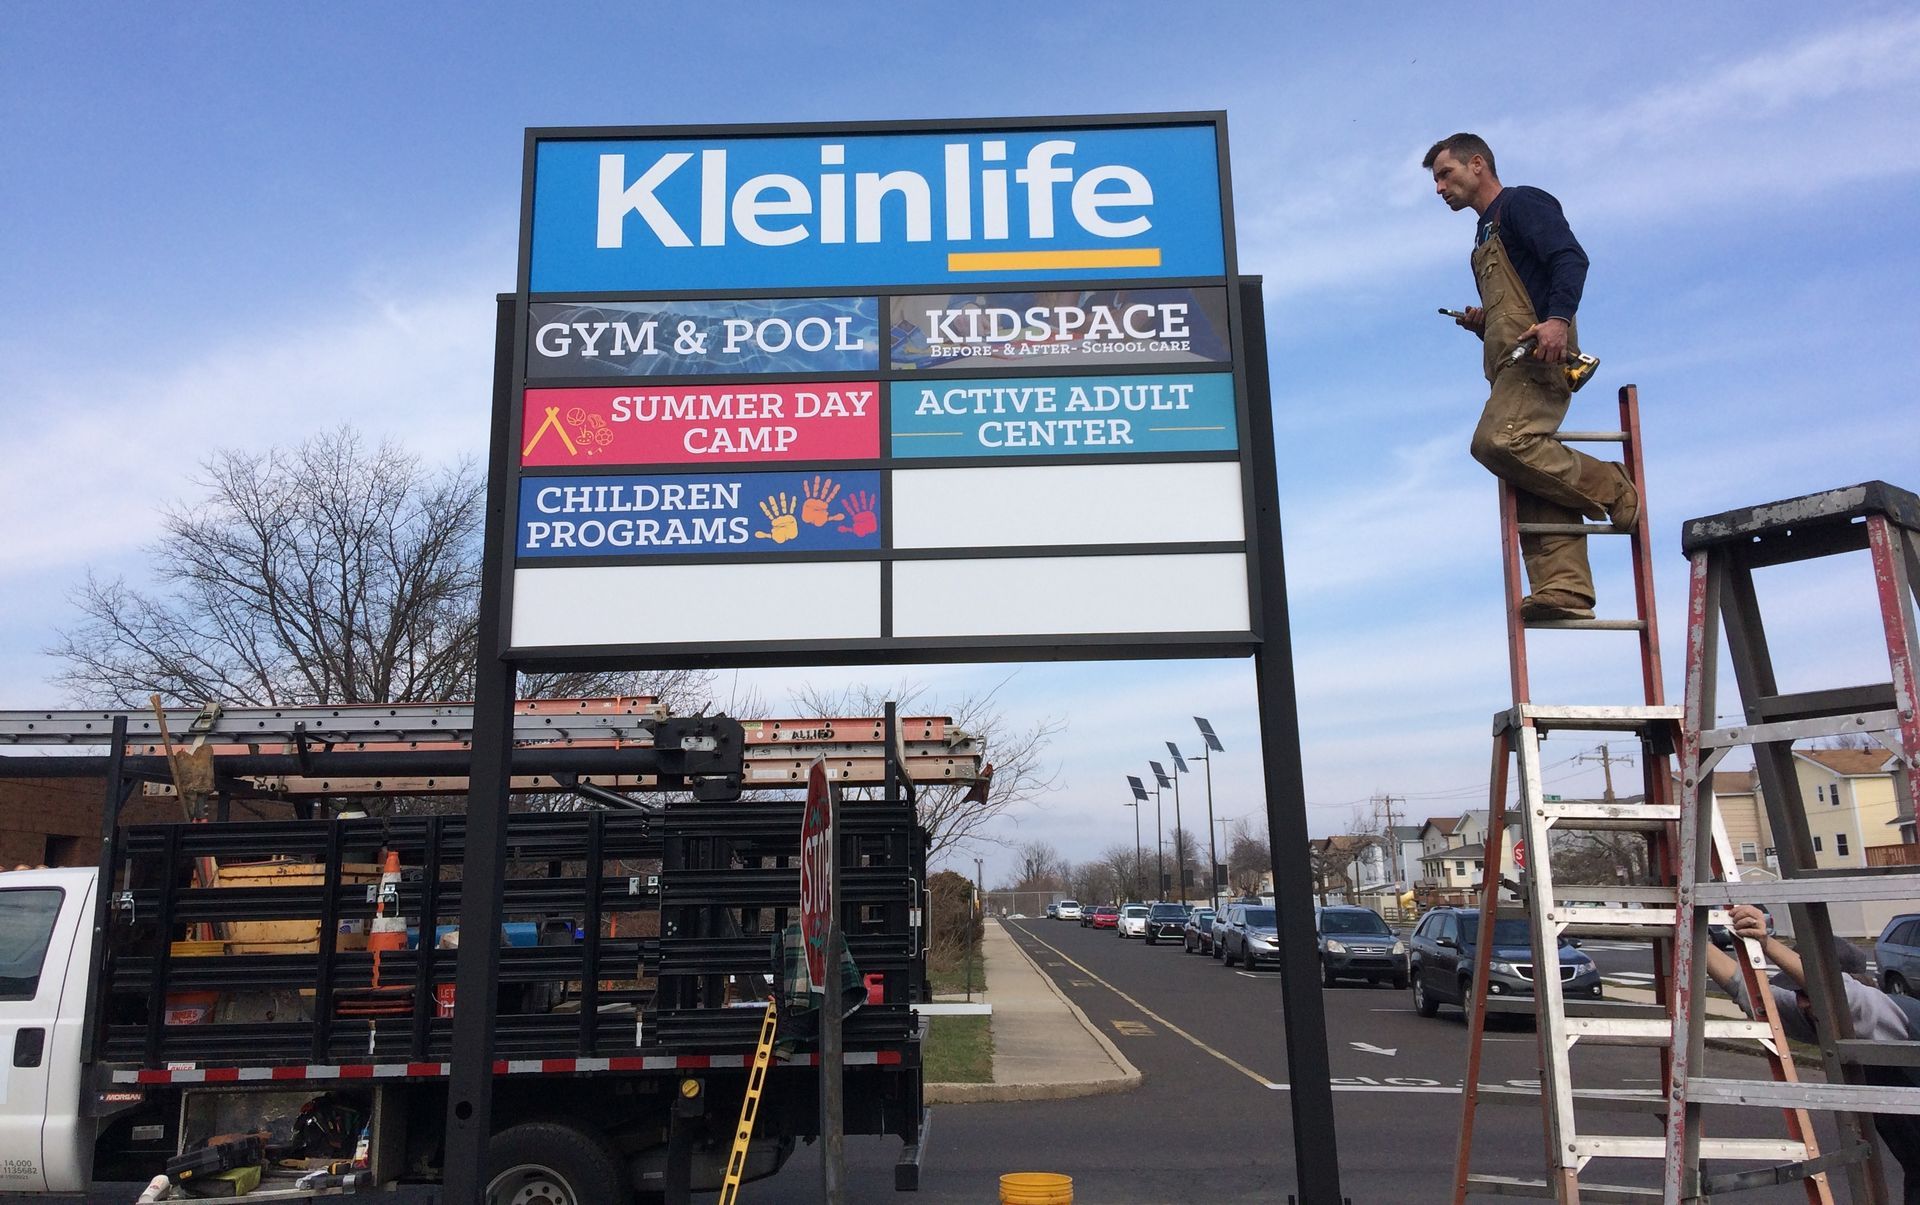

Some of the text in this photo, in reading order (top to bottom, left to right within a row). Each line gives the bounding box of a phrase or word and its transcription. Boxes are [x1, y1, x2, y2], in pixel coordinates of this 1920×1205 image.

[597, 140, 1154, 249] Kleinlife
[535, 316, 864, 358] GYM & POOL
[925, 303, 1190, 344] KIDSPACE
[1004, 343, 1016, 356] &
[1081, 341, 1146, 354] SCHOOL
[1149, 340, 1191, 352] CARE
[611, 391, 873, 422] SUMMER DAY
[915, 384, 1194, 415] ACTIVE ADULT
[683, 426, 798, 454] CAMP
[978, 419, 1134, 448] CENTER
[536, 483, 742, 515] CHILDREN
[526, 516, 749, 549] PROGRAMS
[803, 826, 831, 915] STOP
[106, 1093, 142, 1101] MORGAN
